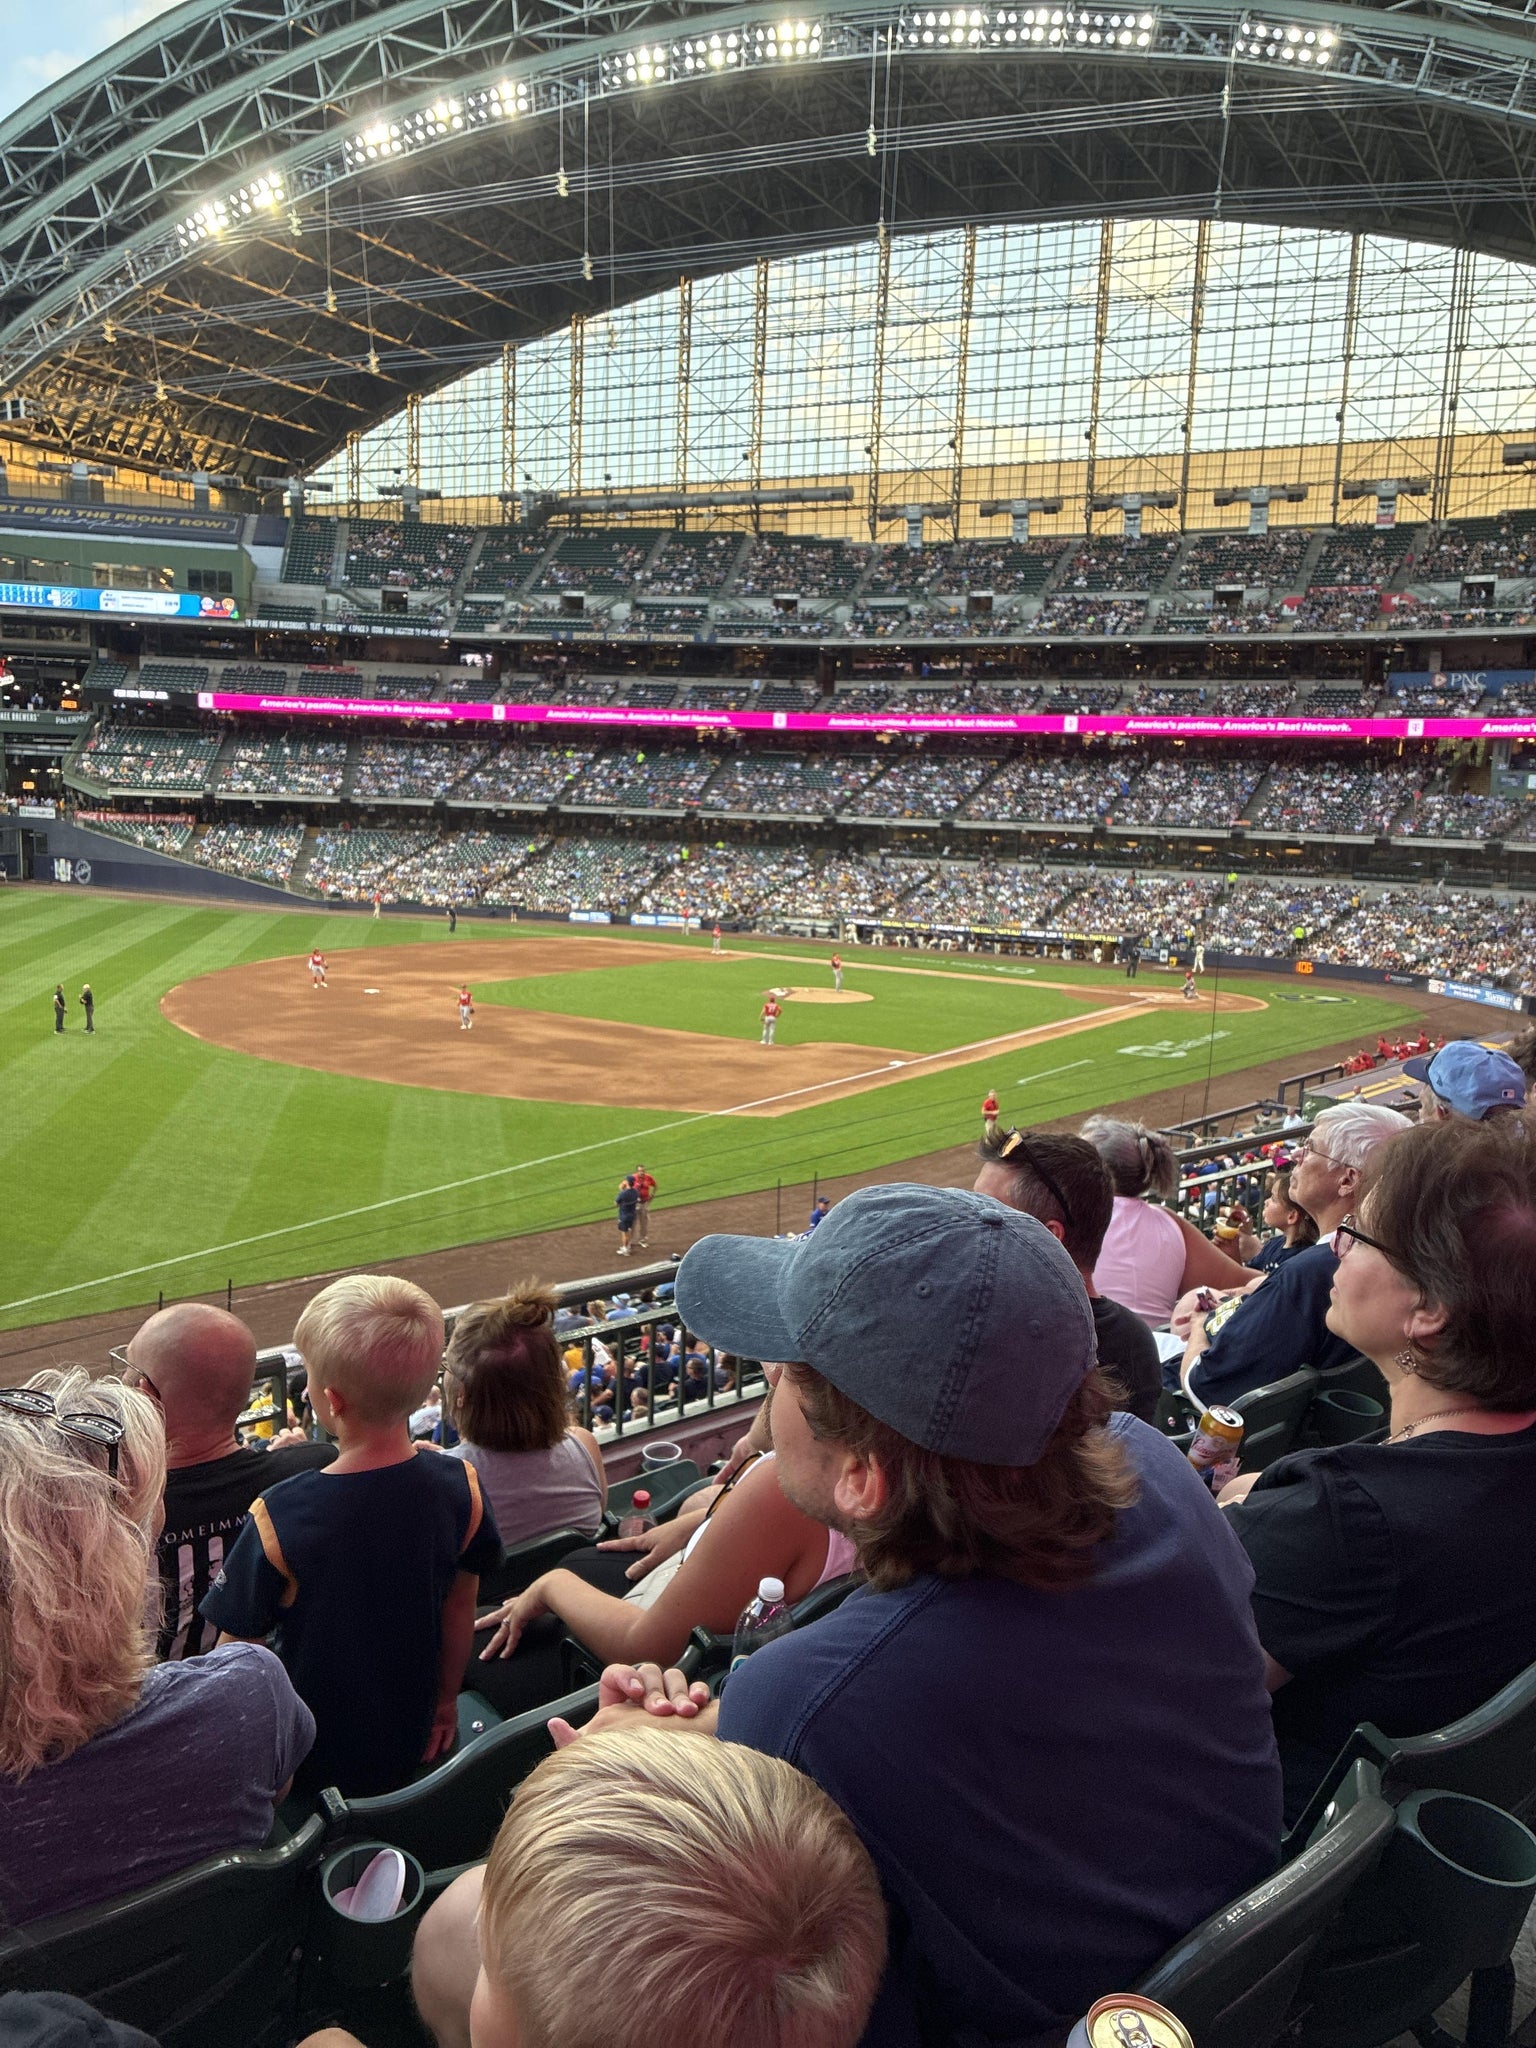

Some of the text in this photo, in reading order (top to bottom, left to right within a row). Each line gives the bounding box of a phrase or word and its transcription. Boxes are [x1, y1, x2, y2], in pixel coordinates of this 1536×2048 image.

[23, 506, 48, 515] BE
[51, 508, 71, 516] IN
[75, 509, 111, 519] THE
[114, 513, 176, 524] FRONT
[180, 518, 228, 529] ROW!
[1451, 672, 1487, 688] PNC
[259, 699, 452, 715] America's pastime. America's Best Network.
[546, 710, 589, 719] America's
[628, 713, 671, 722] America's
[671, 714, 691, 722] Best
[828, 718, 870, 727] America's
[910, 718, 954, 728] America's
[954, 718, 975, 728] Best
[1126, 720, 1352, 732] America's pastime. America's Best Network.
